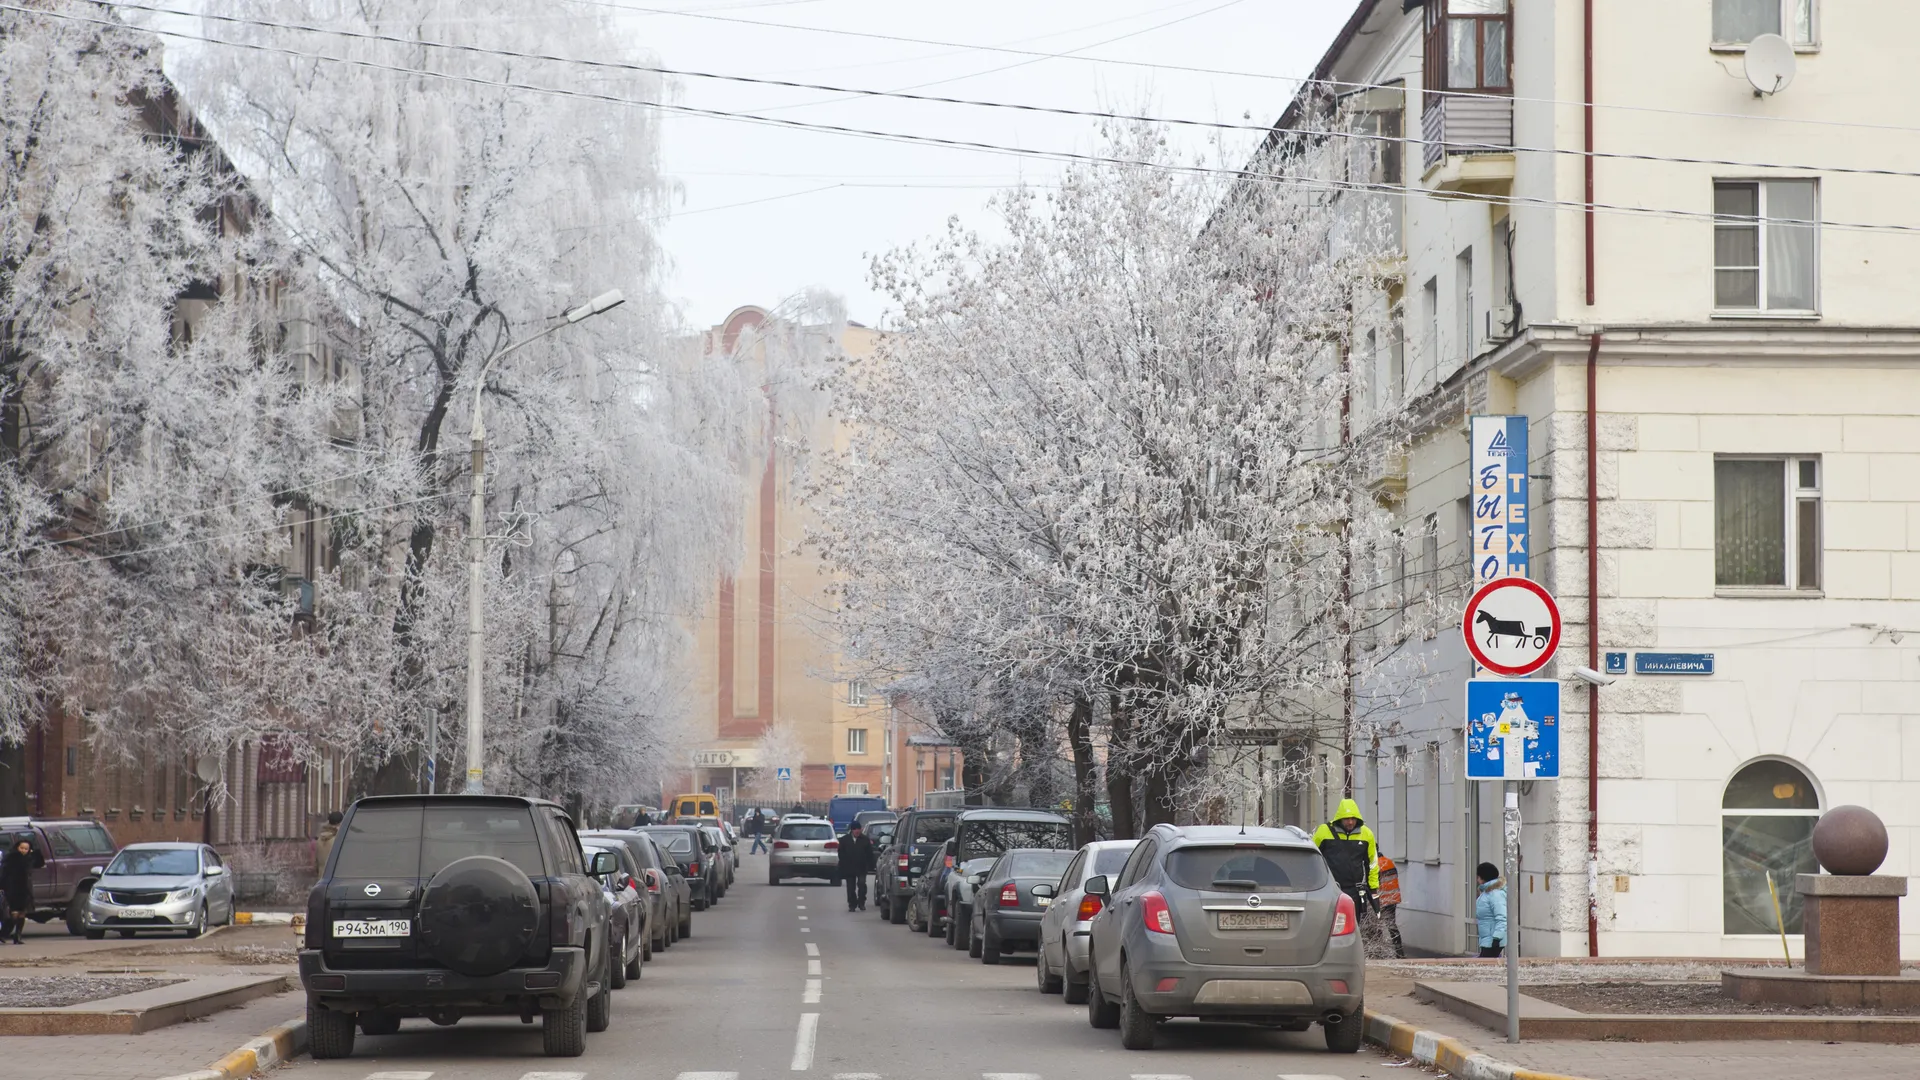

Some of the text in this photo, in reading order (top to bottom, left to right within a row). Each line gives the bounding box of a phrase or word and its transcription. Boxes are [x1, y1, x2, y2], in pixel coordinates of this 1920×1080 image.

[1476, 463, 1503, 580] БЫТО
[1508, 473, 1525, 579] ТЕХН
[1613, 656, 1620, 668] 3
[1644, 662, 1705, 670] МИХАЛЕВИЧА
[1222, 912, 1286, 926] К526КЕ 750
[337, 921, 407, 936] Р943МА 190
